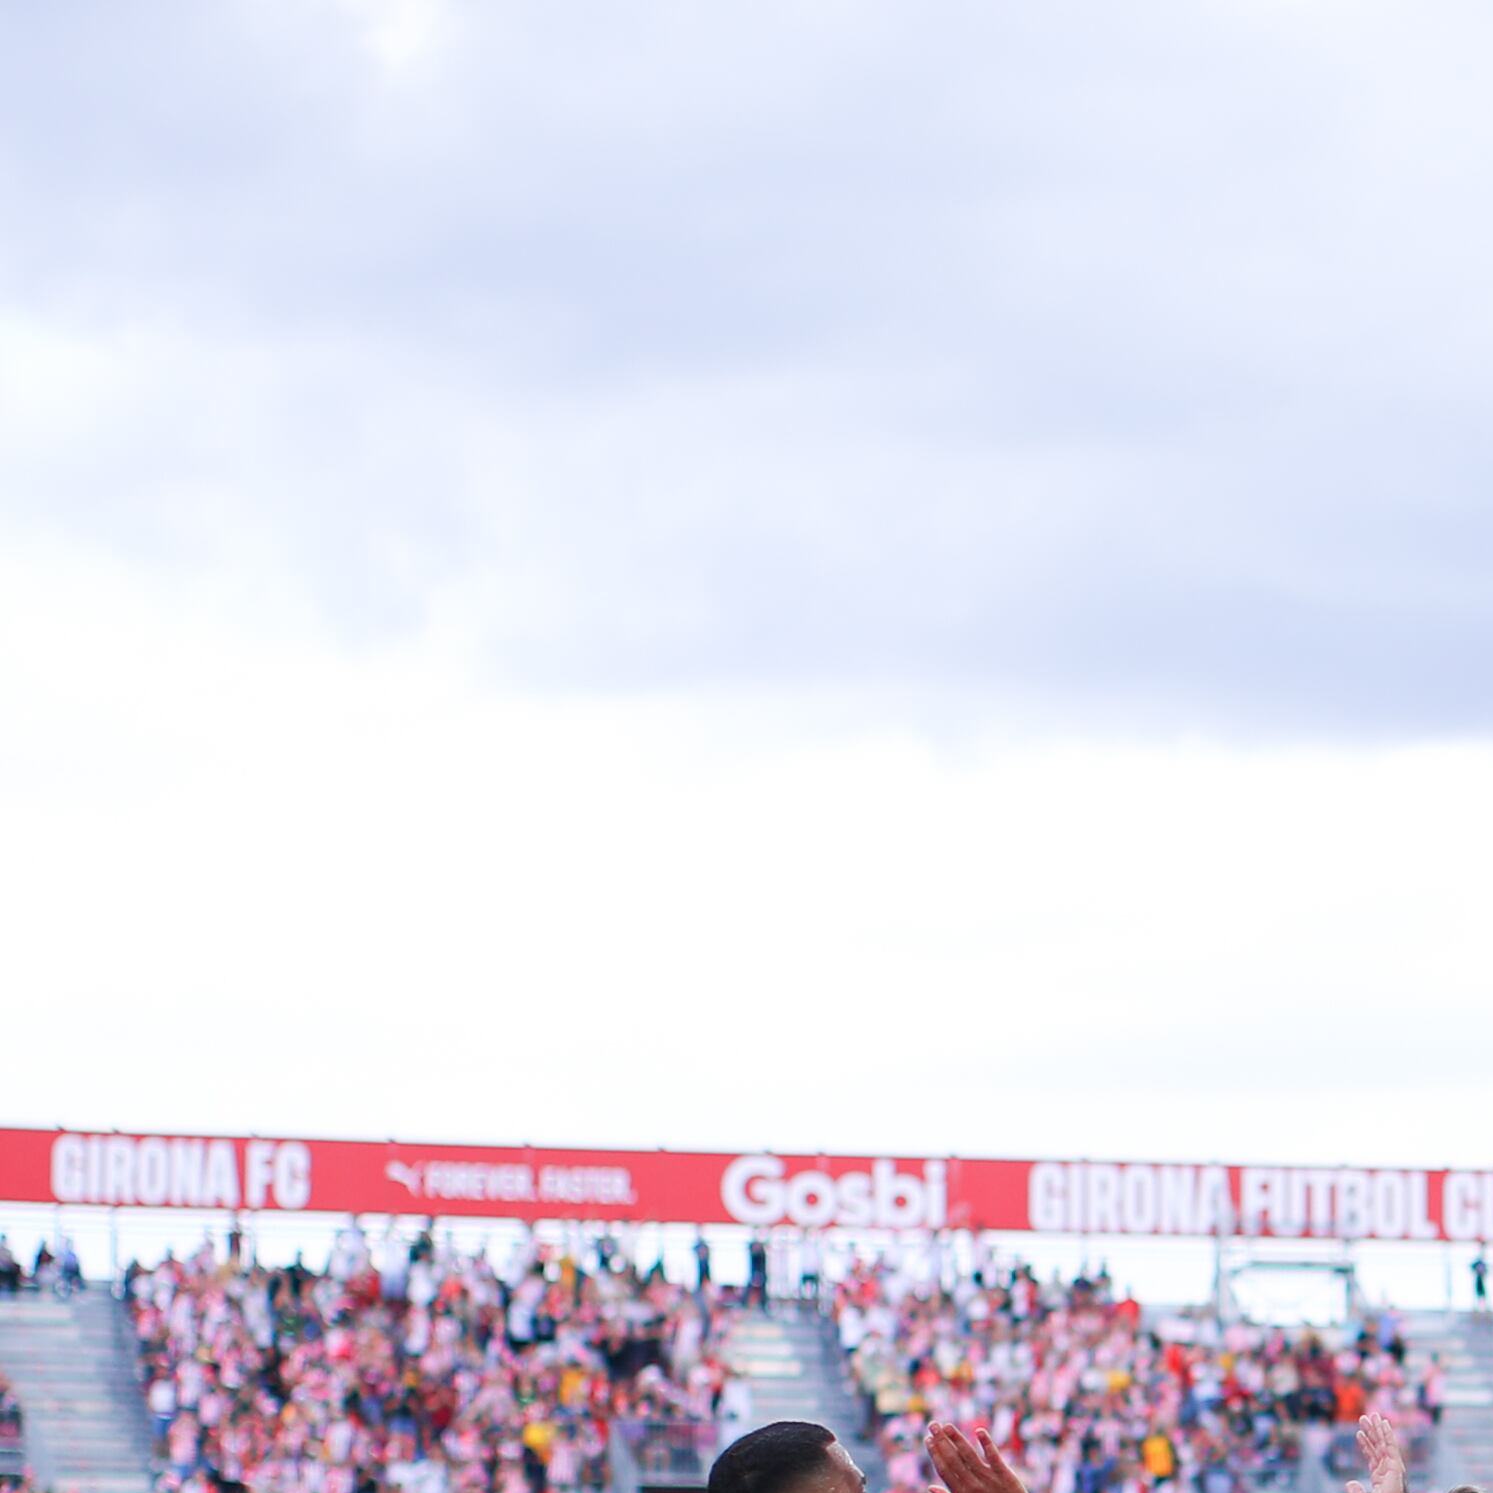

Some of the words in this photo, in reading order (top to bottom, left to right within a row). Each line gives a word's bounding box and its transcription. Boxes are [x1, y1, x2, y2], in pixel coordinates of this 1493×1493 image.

[52, 1133, 240, 1209] GIRONA
[244, 1137, 311, 1210] FC
[721, 1155, 947, 1229] Gosbi
[1029, 1161, 1231, 1236] GIRONA
[1241, 1164, 1436, 1240] FUTBOL
